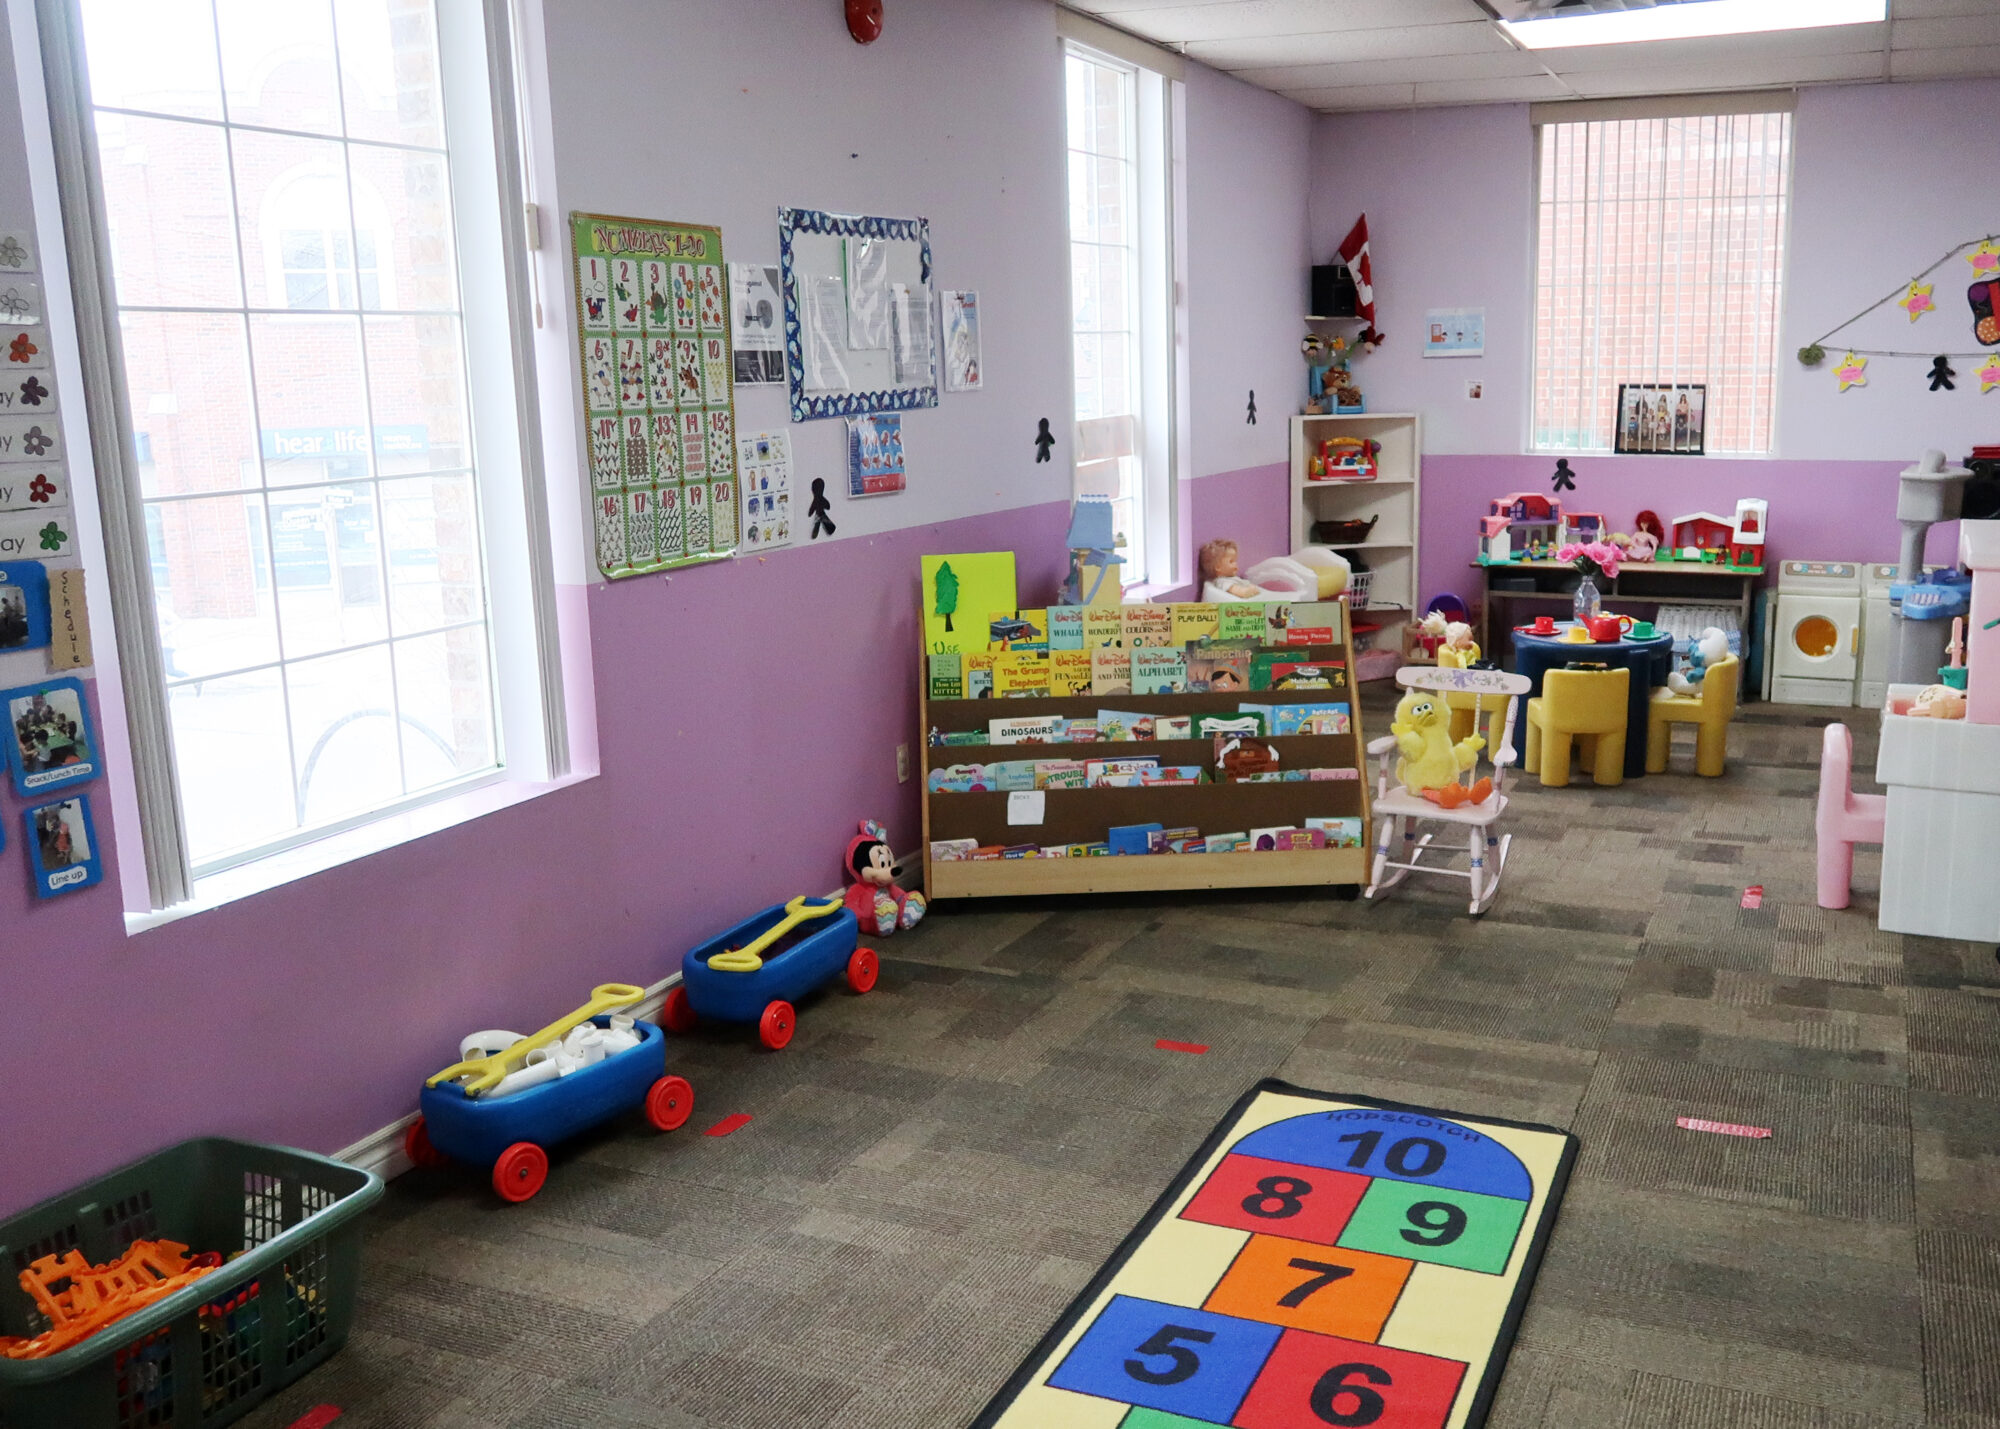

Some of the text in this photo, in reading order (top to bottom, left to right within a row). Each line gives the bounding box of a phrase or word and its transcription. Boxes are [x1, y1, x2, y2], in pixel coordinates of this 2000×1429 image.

[591, 259, 597, 281] 1
[620, 261, 629, 282] 2
[650, 263, 659, 283] 3
[678, 265, 687, 285] 4
[705, 267, 713, 287] 5
[595, 340, 604, 360] 6
[626, 340, 634, 360] 7
[656, 340, 664, 360] 8
[683, 341, 690, 359] 9
[708, 340, 720, 359] 10
[600, 419, 611, 439] 11
[629, 417, 642, 437] 12
[658, 416, 671, 435] 13
[686, 414, 698, 433] 14
[712, 412, 725, 431] 15
[274, 431, 324, 454] hear
[334, 429, 368, 453] life
[662, 490, 675, 509] 18
[690, 486, 701, 505] 19
[715, 483, 729, 502] 20
[603, 497, 616, 517] 16
[634, 493, 646, 513] 17
[1196, 614, 1217, 622] BALL!
[1003, 668, 1018, 676] The
[1138, 666, 1184, 676] ALPHABET
[1009, 678, 1048, 688] Elephant
[1002, 727, 1053, 736] DINOSAURS
[72, 765, 90, 777] Time
[51, 871, 83, 887] Line up
[1326, 1112, 1480, 1142] HOPSCOTCH
[1337, 1130, 1447, 1178] 10
[1241, 1176, 1313, 1219] 8
[1399, 1201, 1467, 1246] 9
[1275, 1257, 1355, 1308] 7
[1124, 1324, 1216, 1386] 5
[1309, 1363, 1393, 1428] 6
